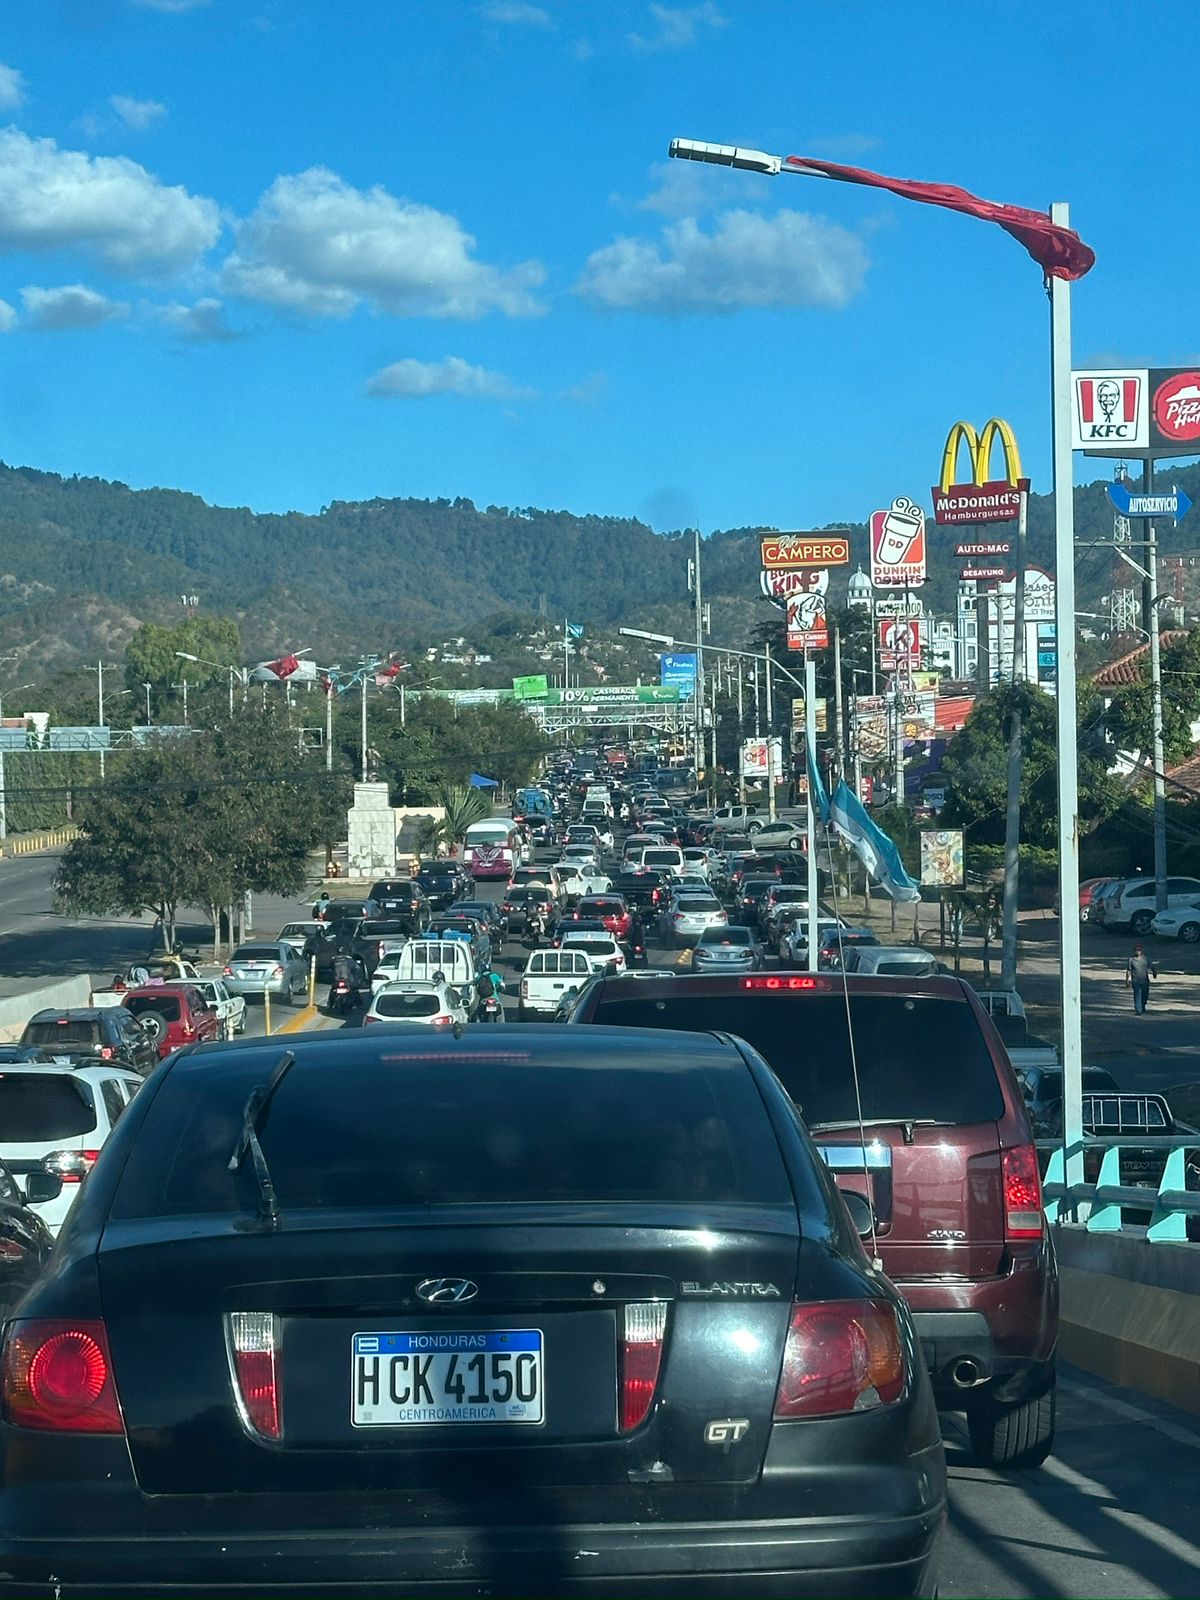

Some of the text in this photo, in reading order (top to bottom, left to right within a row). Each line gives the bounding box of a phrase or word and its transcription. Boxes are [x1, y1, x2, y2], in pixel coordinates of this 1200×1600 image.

[1166, 400, 1200, 420] Pizz
[1089, 424, 1128, 438] KFC
[936, 491, 1020, 511] McDonald's
[1128, 496, 1178, 513] AUTOSERVICIO
[944, 507, 1015, 521] Hamburguesas
[888, 538, 904, 549] DD
[957, 543, 1009, 554] AUTO-MAC
[765, 545, 846, 561] CAMPERO
[874, 566, 924, 575] DUNKIN'
[963, 568, 1004, 577] DESAYUNO
[772, 569, 820, 597] KING
[874, 575, 922, 585] DONUTS
[559, 690, 588, 702] 10%
[1122, 1160, 1164, 1170] TOYOT
[680, 1281, 781, 1296] ELANTRA
[408, 1335, 487, 1348] HONDURAS
[444, 1352, 537, 1404] 4150
[706, 1418, 750, 1442] GT
